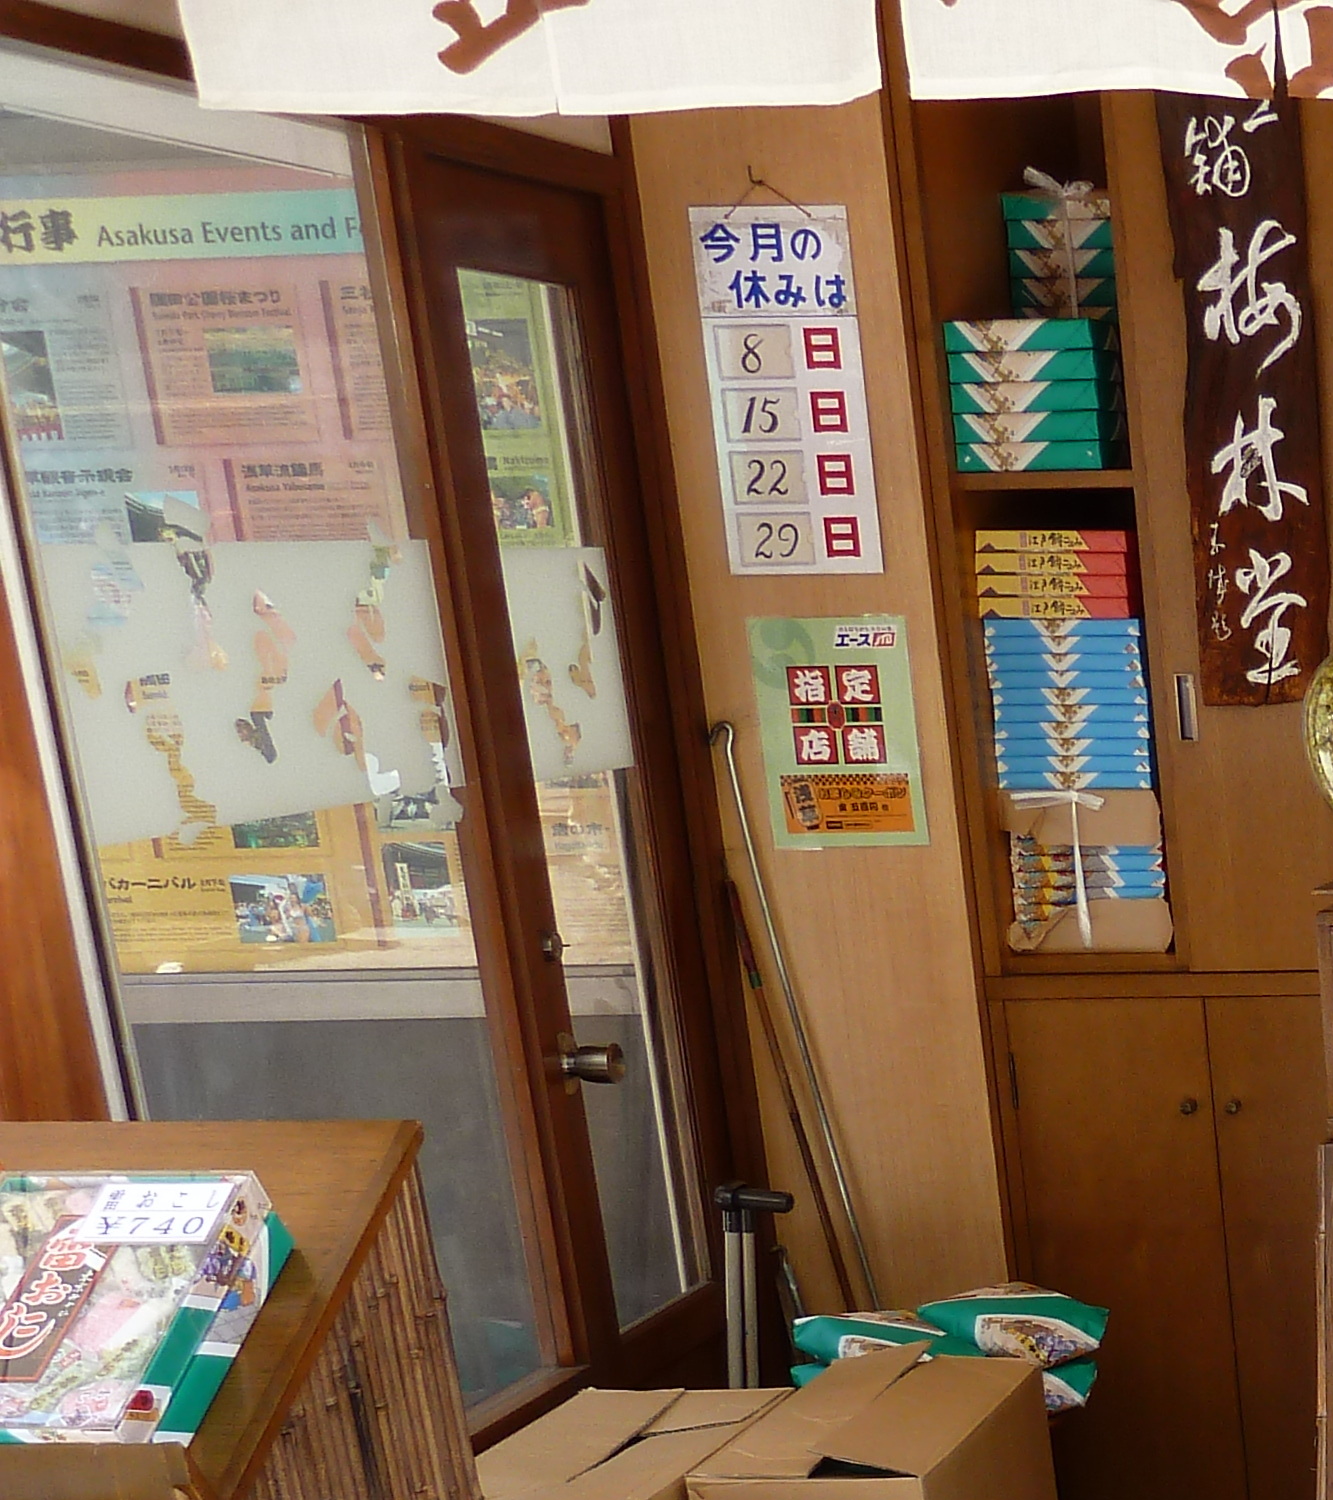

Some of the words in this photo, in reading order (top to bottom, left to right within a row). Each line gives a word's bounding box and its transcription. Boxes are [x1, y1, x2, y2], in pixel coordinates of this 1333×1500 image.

[97, 225, 195, 248] Asakusa
[202, 221, 283, 244] Events
[291, 216, 337, 241] and
[700, 223, 822, 262] 今月の
[729, 271, 847, 309] 休みは
[740, 332, 765, 374] 8
[803, 327, 842, 370] 日
[743, 396, 780, 435] 15
[810, 391, 848, 434] 日
[746, 460, 789, 497] 22
[816, 454, 855, 496] 日
[755, 522, 799, 560] 29
[823, 516, 859, 559] 日
[835, 633, 871, 647] エース
[793, 669, 875, 703] 指定
[800, 728, 881, 761] 店舗
[103, 1188, 221, 1212] 雷おこし
[98, 1215, 205, 1237] ¥740
